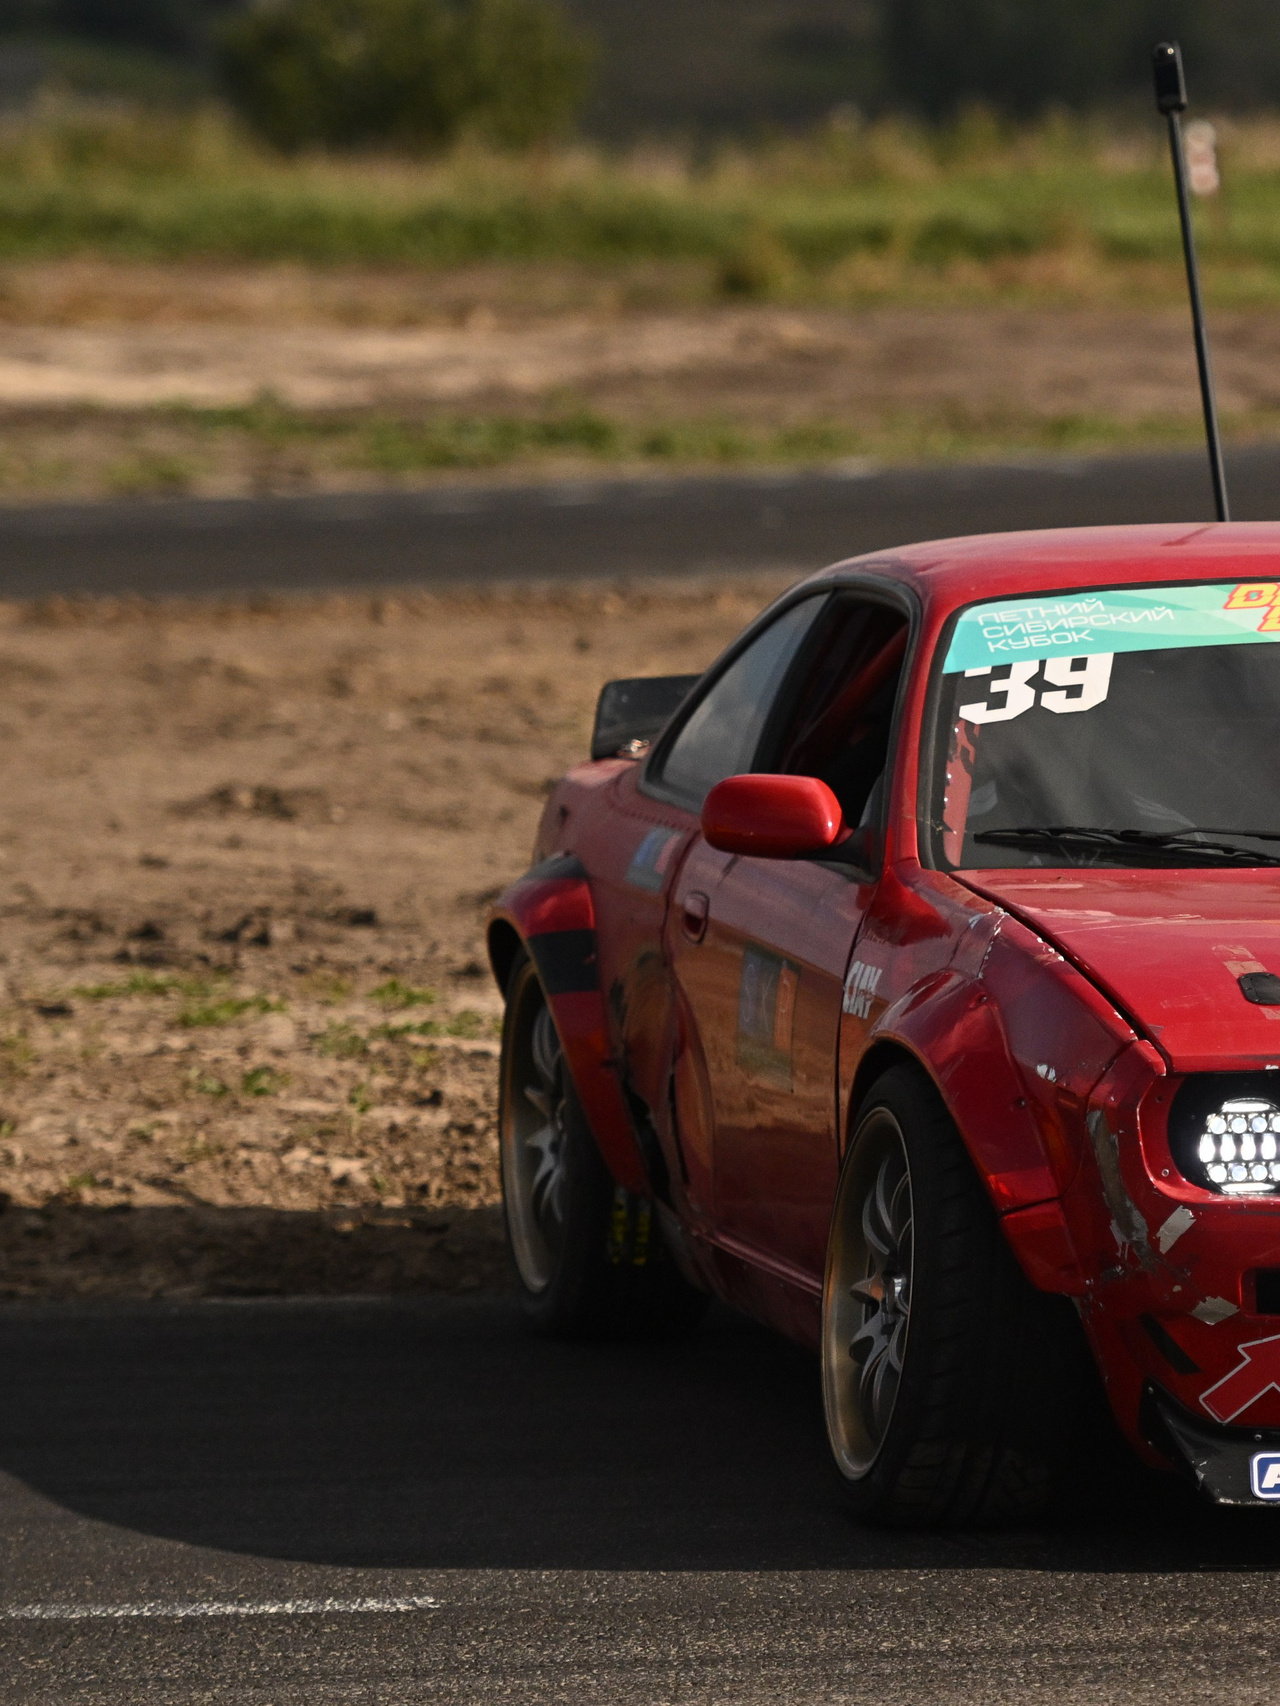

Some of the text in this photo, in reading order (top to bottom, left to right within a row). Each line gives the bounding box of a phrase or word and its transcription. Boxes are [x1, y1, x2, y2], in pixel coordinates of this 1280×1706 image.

[978, 597, 1105, 626] ЛЕТНИЙ
[982, 606, 1176, 640] СИБИРСКИЙ
[987, 629, 1094, 653] КУБОК
[958, 652, 1114, 725] 39
